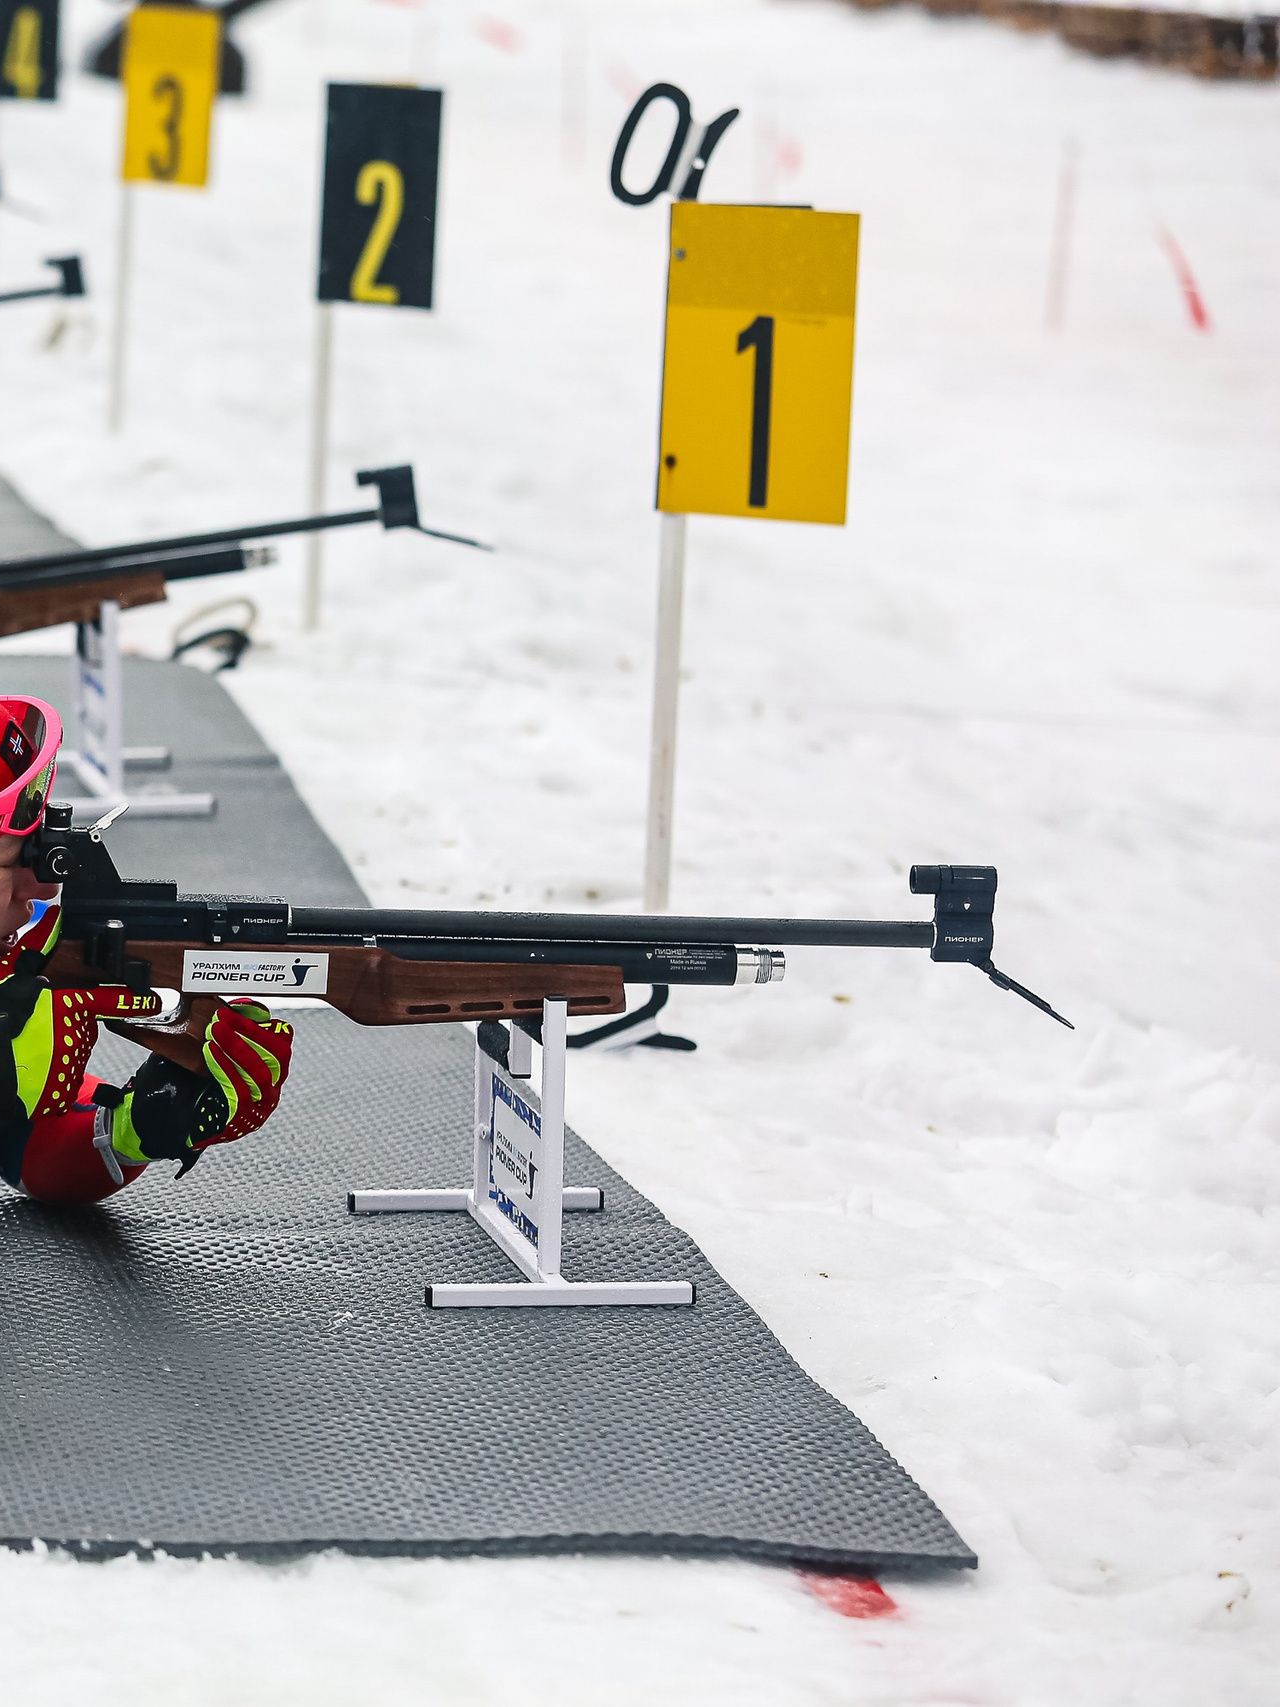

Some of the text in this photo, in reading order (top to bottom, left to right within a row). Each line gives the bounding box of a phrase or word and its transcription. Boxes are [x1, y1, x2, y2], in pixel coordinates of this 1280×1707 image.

[1, 7, 43, 98] 4
[148, 73, 183, 181] 3
[350, 160, 404, 305] 2
[735, 315, 774, 508] 1
[191, 972, 286, 983] PIONER CUP
[192, 962, 241, 970] УРАЛХИМ
[116, 994, 157, 1010] LEKI
[495, 1145, 528, 1186] PIONER CUP
